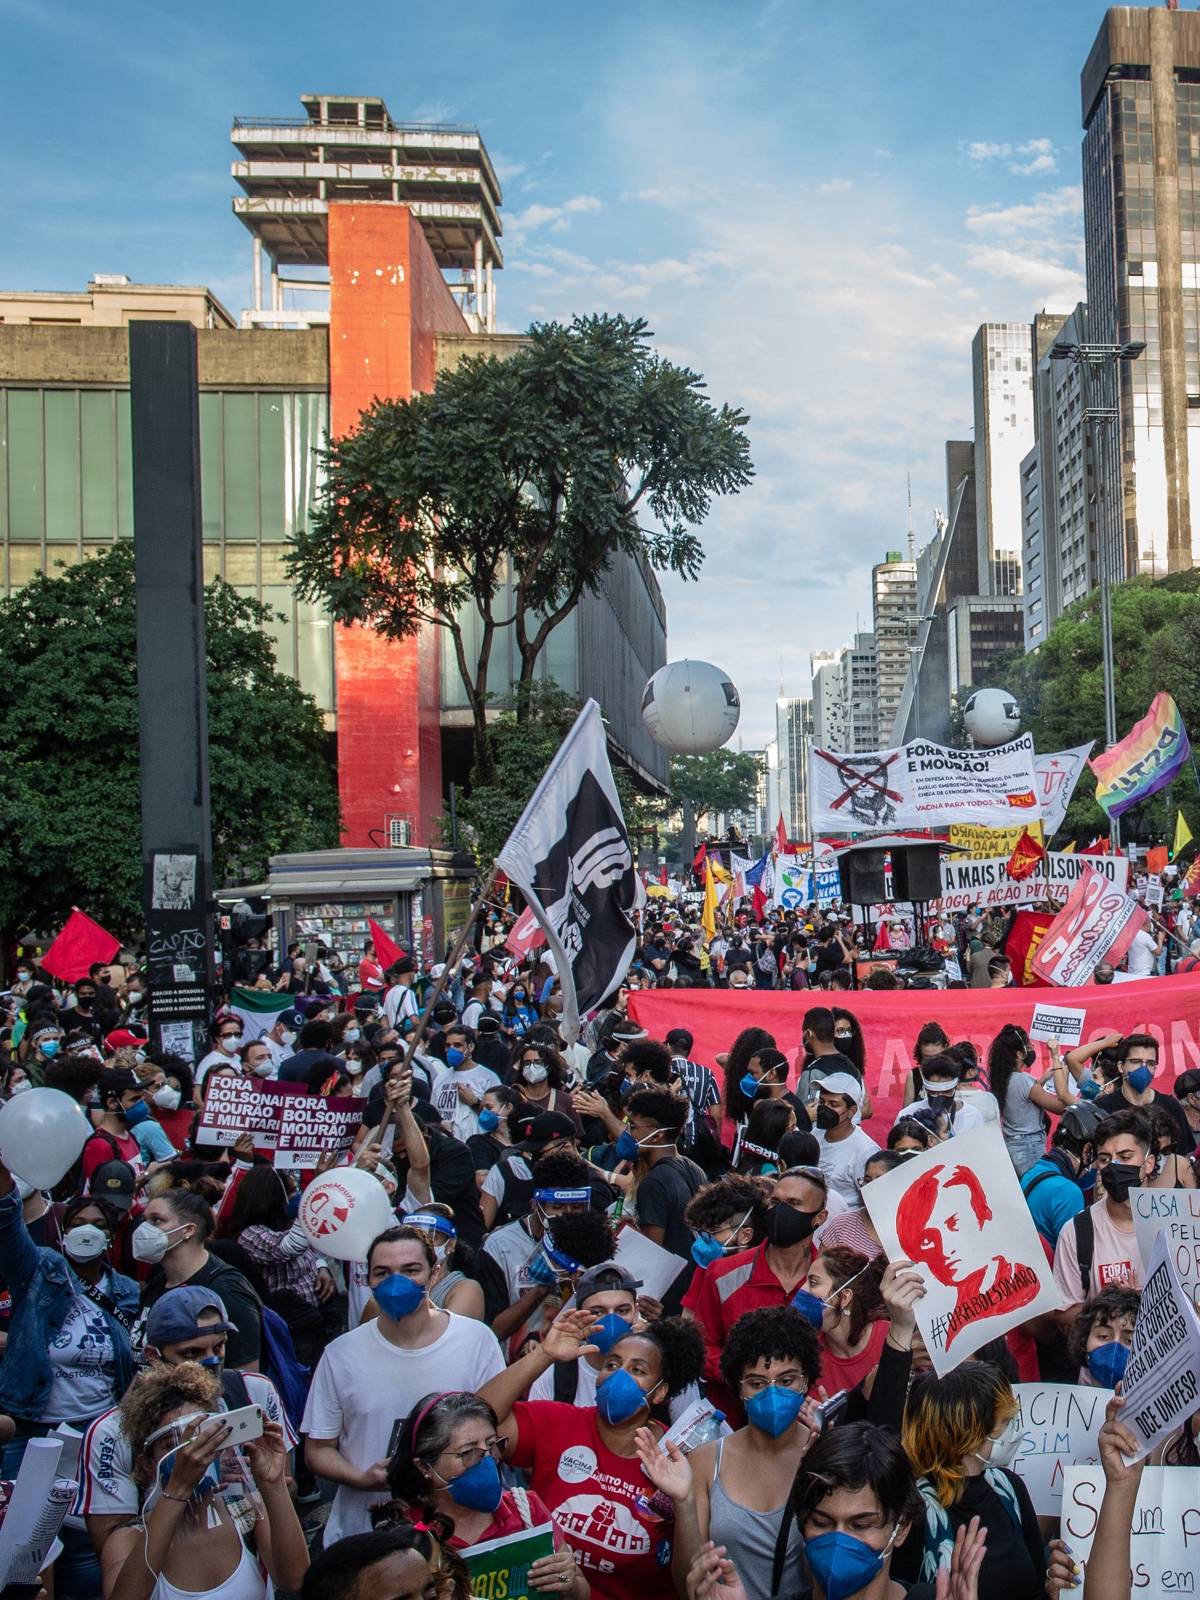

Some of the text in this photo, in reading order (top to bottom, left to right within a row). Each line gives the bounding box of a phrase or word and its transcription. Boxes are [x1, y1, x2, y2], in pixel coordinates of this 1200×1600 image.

[906, 738, 1032, 759] FORA BOLSONARO
[908, 759, 989, 772] E MOURÃO!
[916, 803, 944, 811] VACINA
[958, 864, 995, 889] MAIS
[988, 886, 1021, 904] AÇÃO
[1034, 1023, 1055, 1032] TODAS
[1037, 1014, 1079, 1026] VACINA PARA
[210, 1076, 253, 1091] FORA
[208, 1089, 283, 1107] BOLSONA
[284, 1097, 327, 1110] FORA
[205, 1100, 273, 1118] MOURÃO
[203, 1113, 280, 1131] E MILITAR
[281, 1121, 346, 1136] MOURÃO
[280, 1137, 290, 1147] E
[1136, 1194, 1179, 1219] CASA
[1102, 1263, 1130, 1279] FORA
[930, 1266, 1037, 1349] #FORABOLSONARO
[1146, 1292, 1180, 1345] CORTES
[1122, 1315, 1188, 1396] DEFESA DA UNIFESP
[56, 1370, 96, 1379] GOSTOSO
[1135, 1403, 1163, 1441] DCE
[1154, 1369, 1200, 1424] UNIFESP
[563, 1455, 593, 1472] VACINA
[623, 1480, 635, 1492] DE
[1161, 1567, 1195, 1592] em
